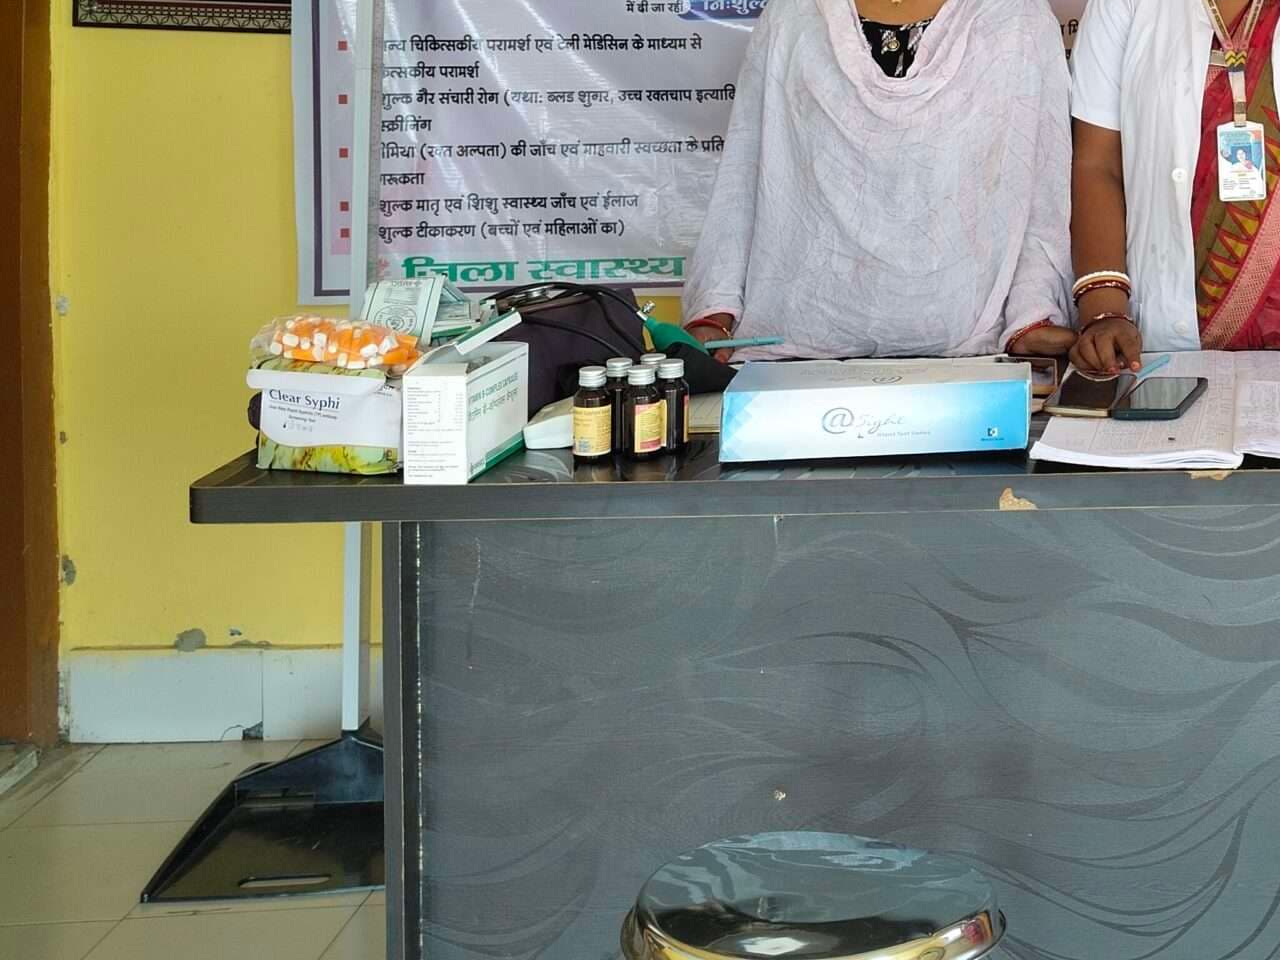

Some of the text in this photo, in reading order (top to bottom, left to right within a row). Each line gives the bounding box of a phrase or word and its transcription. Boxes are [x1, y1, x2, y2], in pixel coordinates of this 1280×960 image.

[637, 0, 648, 14] दी
[650, 2, 665, 13] जा
[410, 33, 703, 53] चिकित्सकीय परामर्श एवं टेली मेडिसिन के माध्यम से
[439, 60, 480, 78] परामर्श
[416, 89, 435, 105] गैर
[438, 87, 474, 105] संचारी
[477, 87, 499, 105] रोग
[547, 91, 575, 103] ब्लड
[618, 90, 643, 102] उच्च
[646, 89, 692, 103] रक्तचाप
[456, 141, 507, 160] अल्पता)
[510, 139, 526, 157] की
[530, 139, 556, 157] जाँच
[560, 139, 580, 158] एवं
[583, 137, 631, 157] माहवारी
[634, 140, 682, 154] स्वच्छता
[685, 135, 698, 153] के
[700, 135, 725, 153] प्रति
[379, 190, 639, 217] शुल्क मातृ एवं शिशु स्वास्थ्य जाँच एवं ईलाज
[378, 225, 413, 244] शुल्क
[416, 220, 476, 239] टीकाकरण
[523, 218, 543, 238] एवं
[544, 217, 598, 237] महिलाओं
[600, 219, 625, 237] का)
[526, 255, 686, 281] स्वास्थ्य
[269, 389, 341, 411] Clear Syphi
